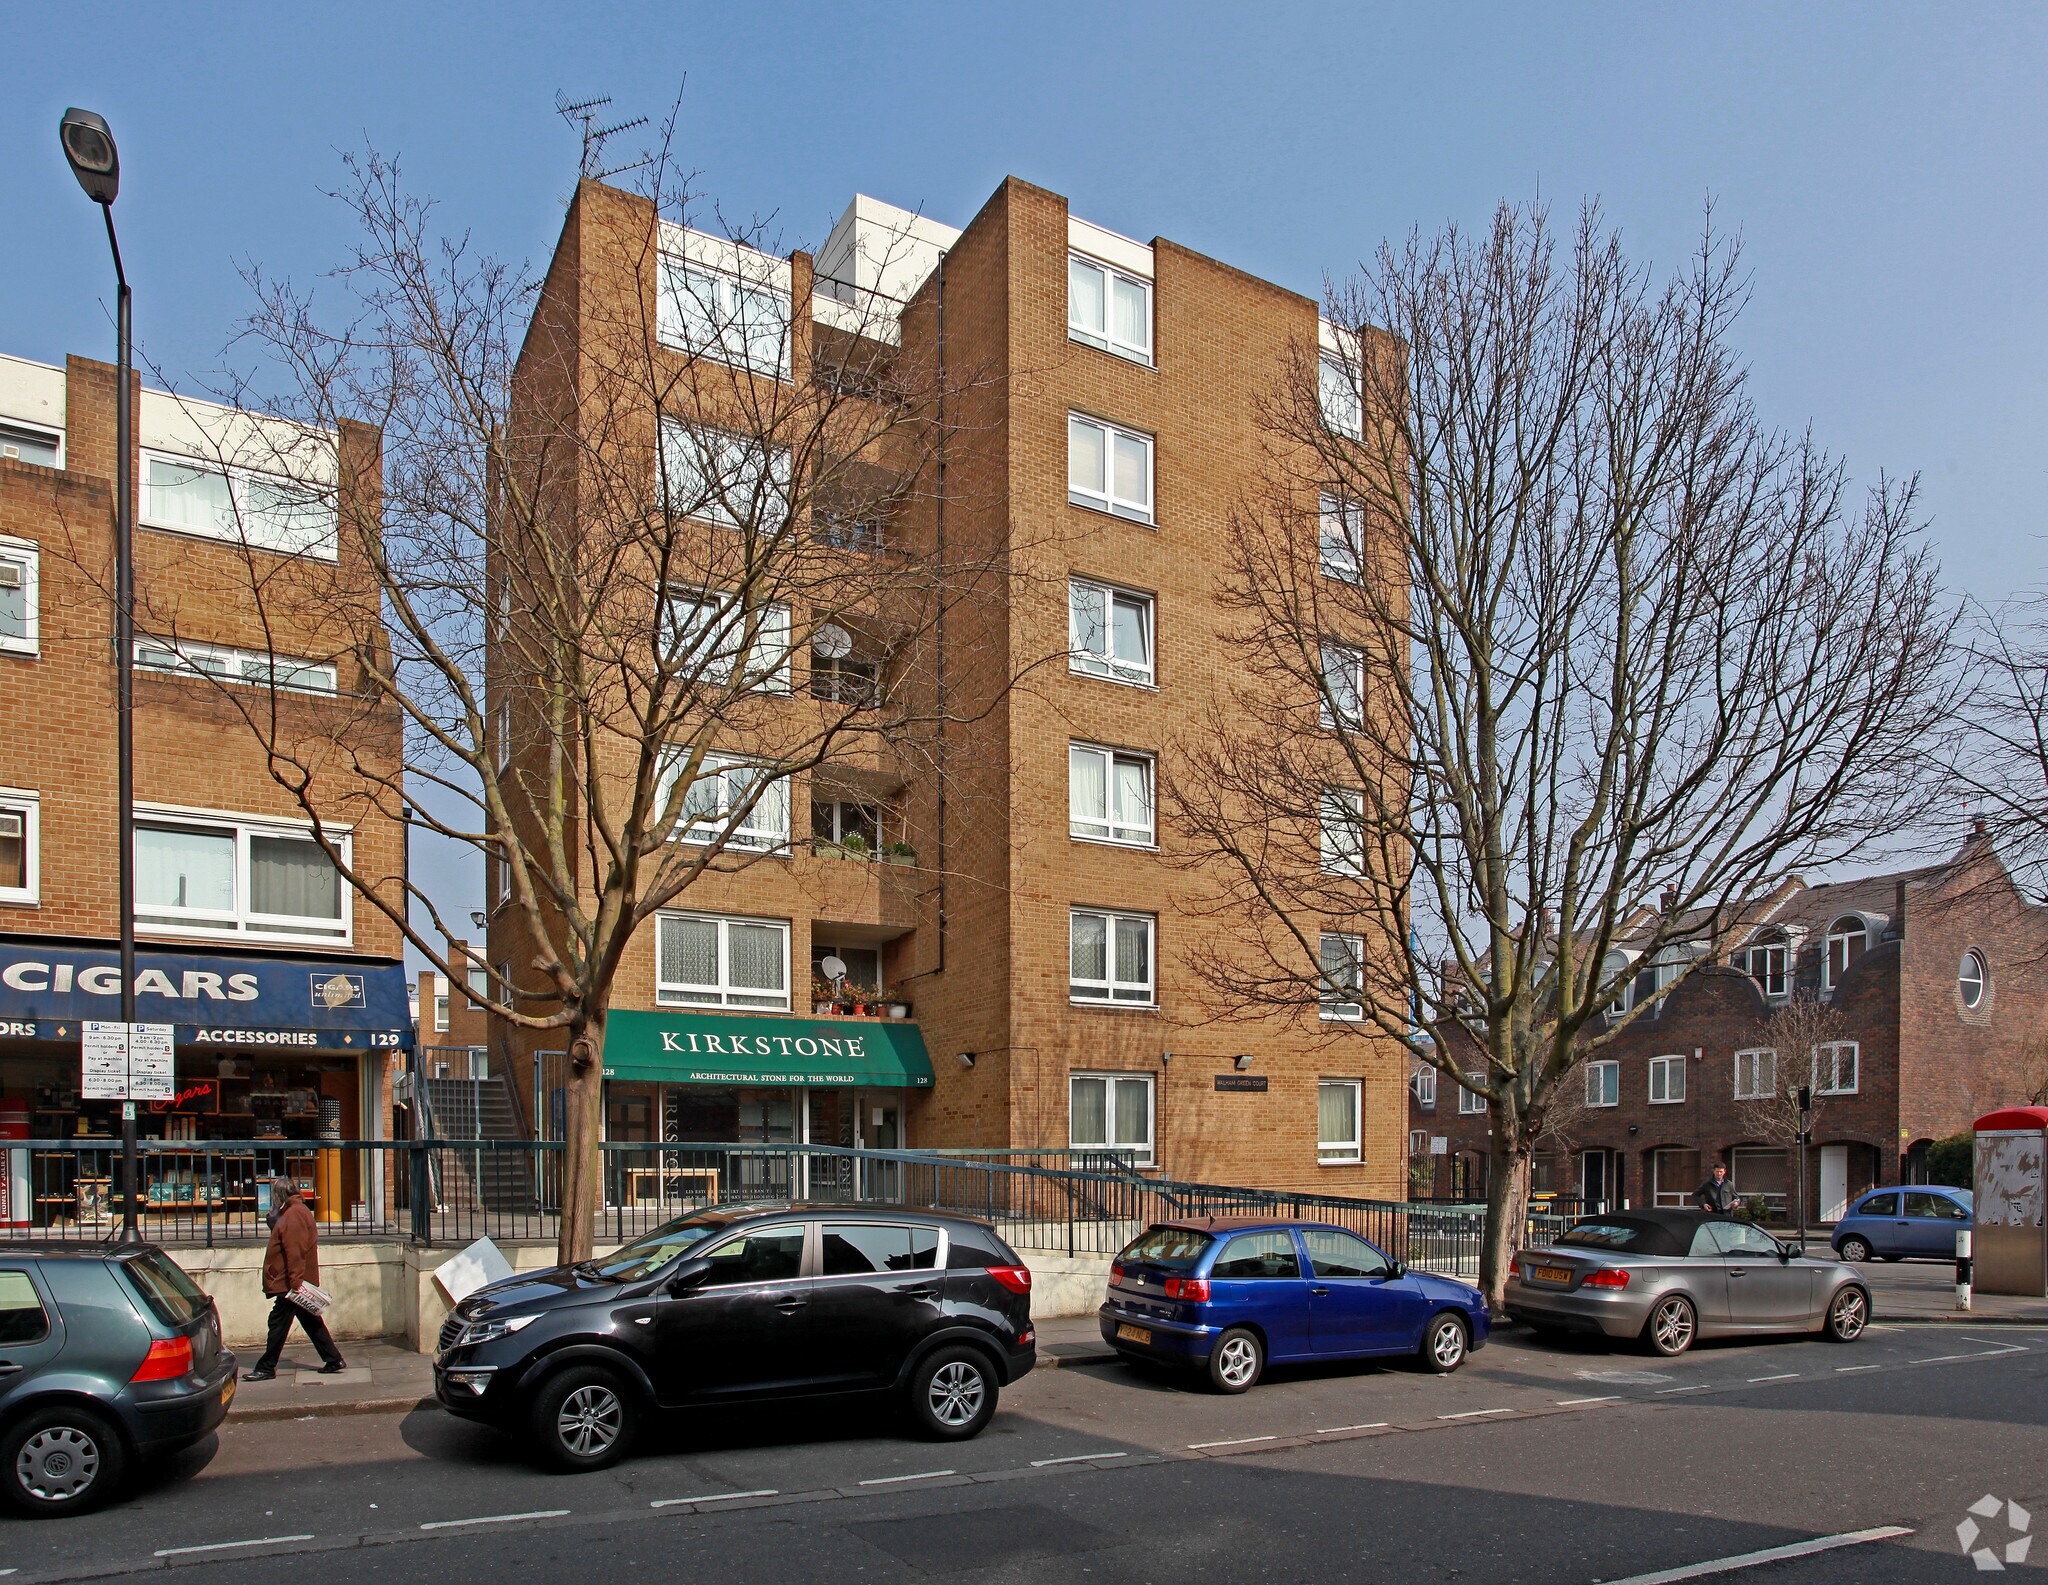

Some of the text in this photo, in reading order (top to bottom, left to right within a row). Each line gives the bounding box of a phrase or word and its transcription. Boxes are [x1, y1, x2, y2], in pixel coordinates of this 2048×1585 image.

[3, 962, 260, 1000] CIGARS
[315, 983, 360, 991] CIGARS
[195, 1029, 317, 1045] ACCESSORIES
[370, 1033, 400, 1045] 129
[659, 1031, 865, 1058] KIRKSTONE
[602, 1068, 615, 1076] 128
[690, 1072, 758, 1081] ARCHITECTURAL
[294, 1295, 320, 1313] MAGGIE
